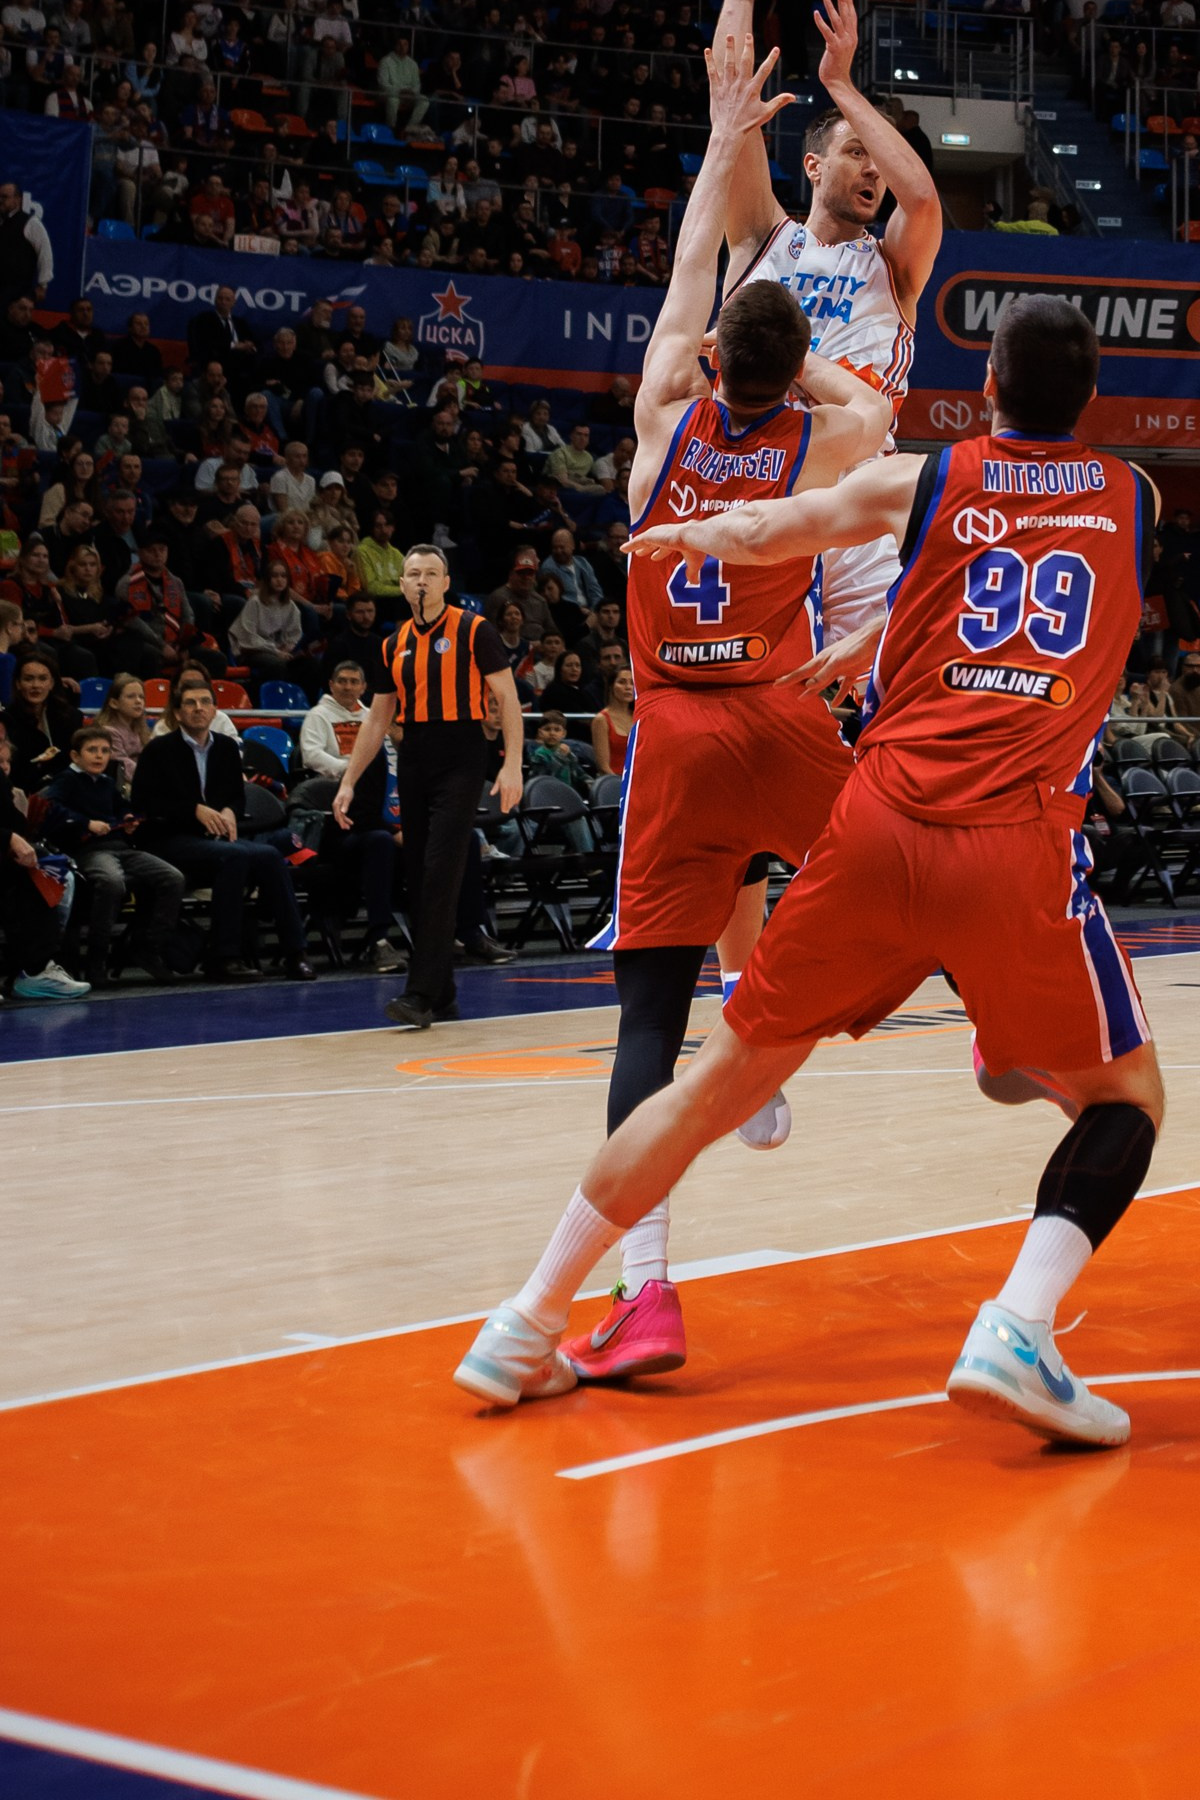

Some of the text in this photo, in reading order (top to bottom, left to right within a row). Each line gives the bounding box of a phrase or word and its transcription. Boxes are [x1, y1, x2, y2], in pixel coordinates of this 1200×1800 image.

[779, 272, 867, 296] ETCITY
[801, 297, 853, 324] RMA
[426, 324, 476, 347] ЦСКА
[982, 460, 1106, 495] MITROVIC
[1016, 516, 1117, 533] НОРНИКЕЛЬ
[666, 554, 731, 625] 4
[957, 547, 1096, 660] 99
[951, 666, 1051, 696] WINLINE
